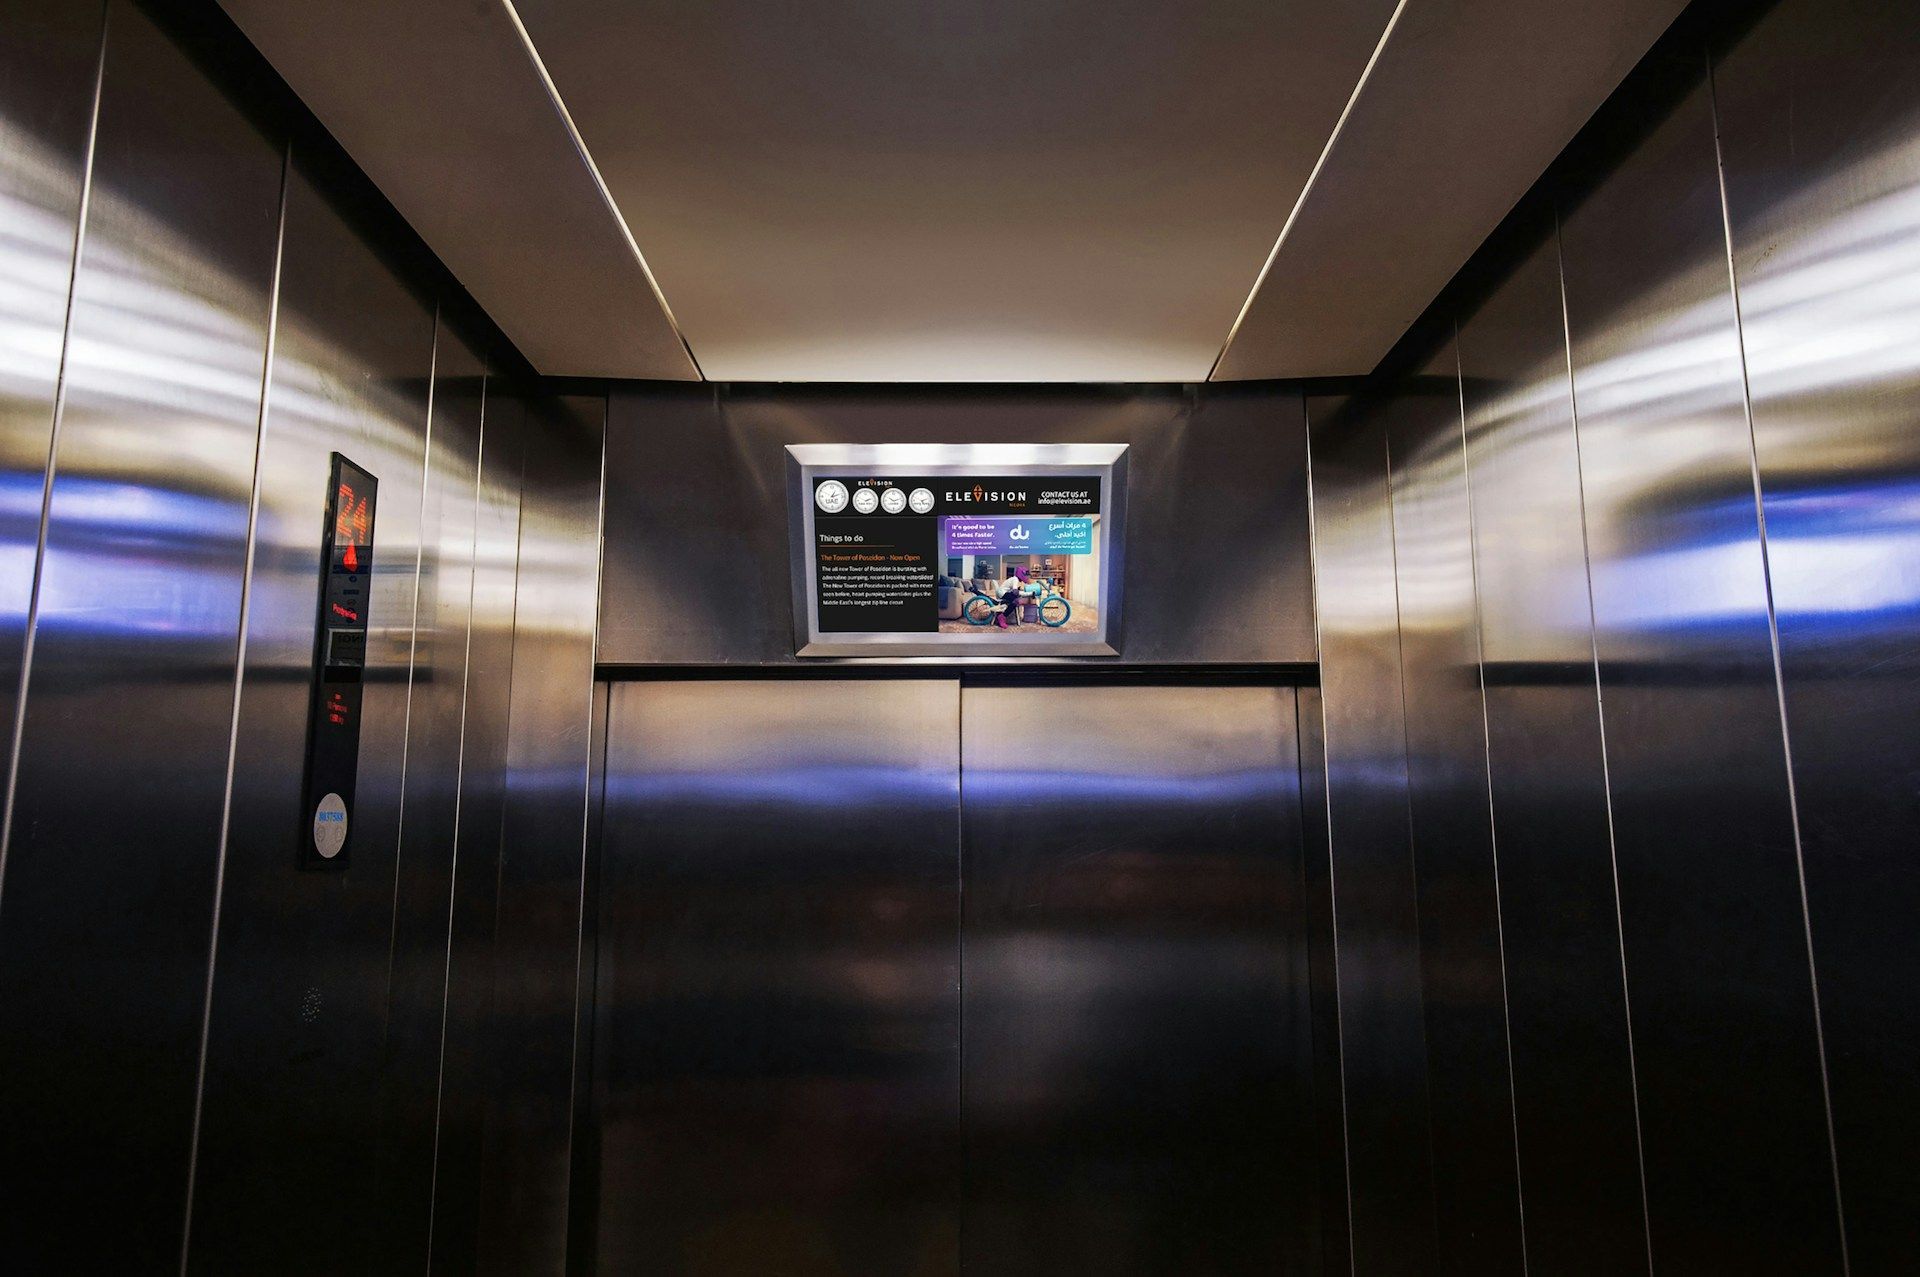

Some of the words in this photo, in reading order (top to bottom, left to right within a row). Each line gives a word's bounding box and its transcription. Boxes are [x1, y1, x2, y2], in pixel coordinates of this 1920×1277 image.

[945, 485, 1027, 502] ELEVISION
[1037, 497, 1091, 505] info@elevision.ae
[336, 483, 367, 544] 24
[1009, 524, 1030, 540] du
[819, 534, 843, 544] Things
[853, 534, 864, 542] do
[904, 554, 921, 562] Open
